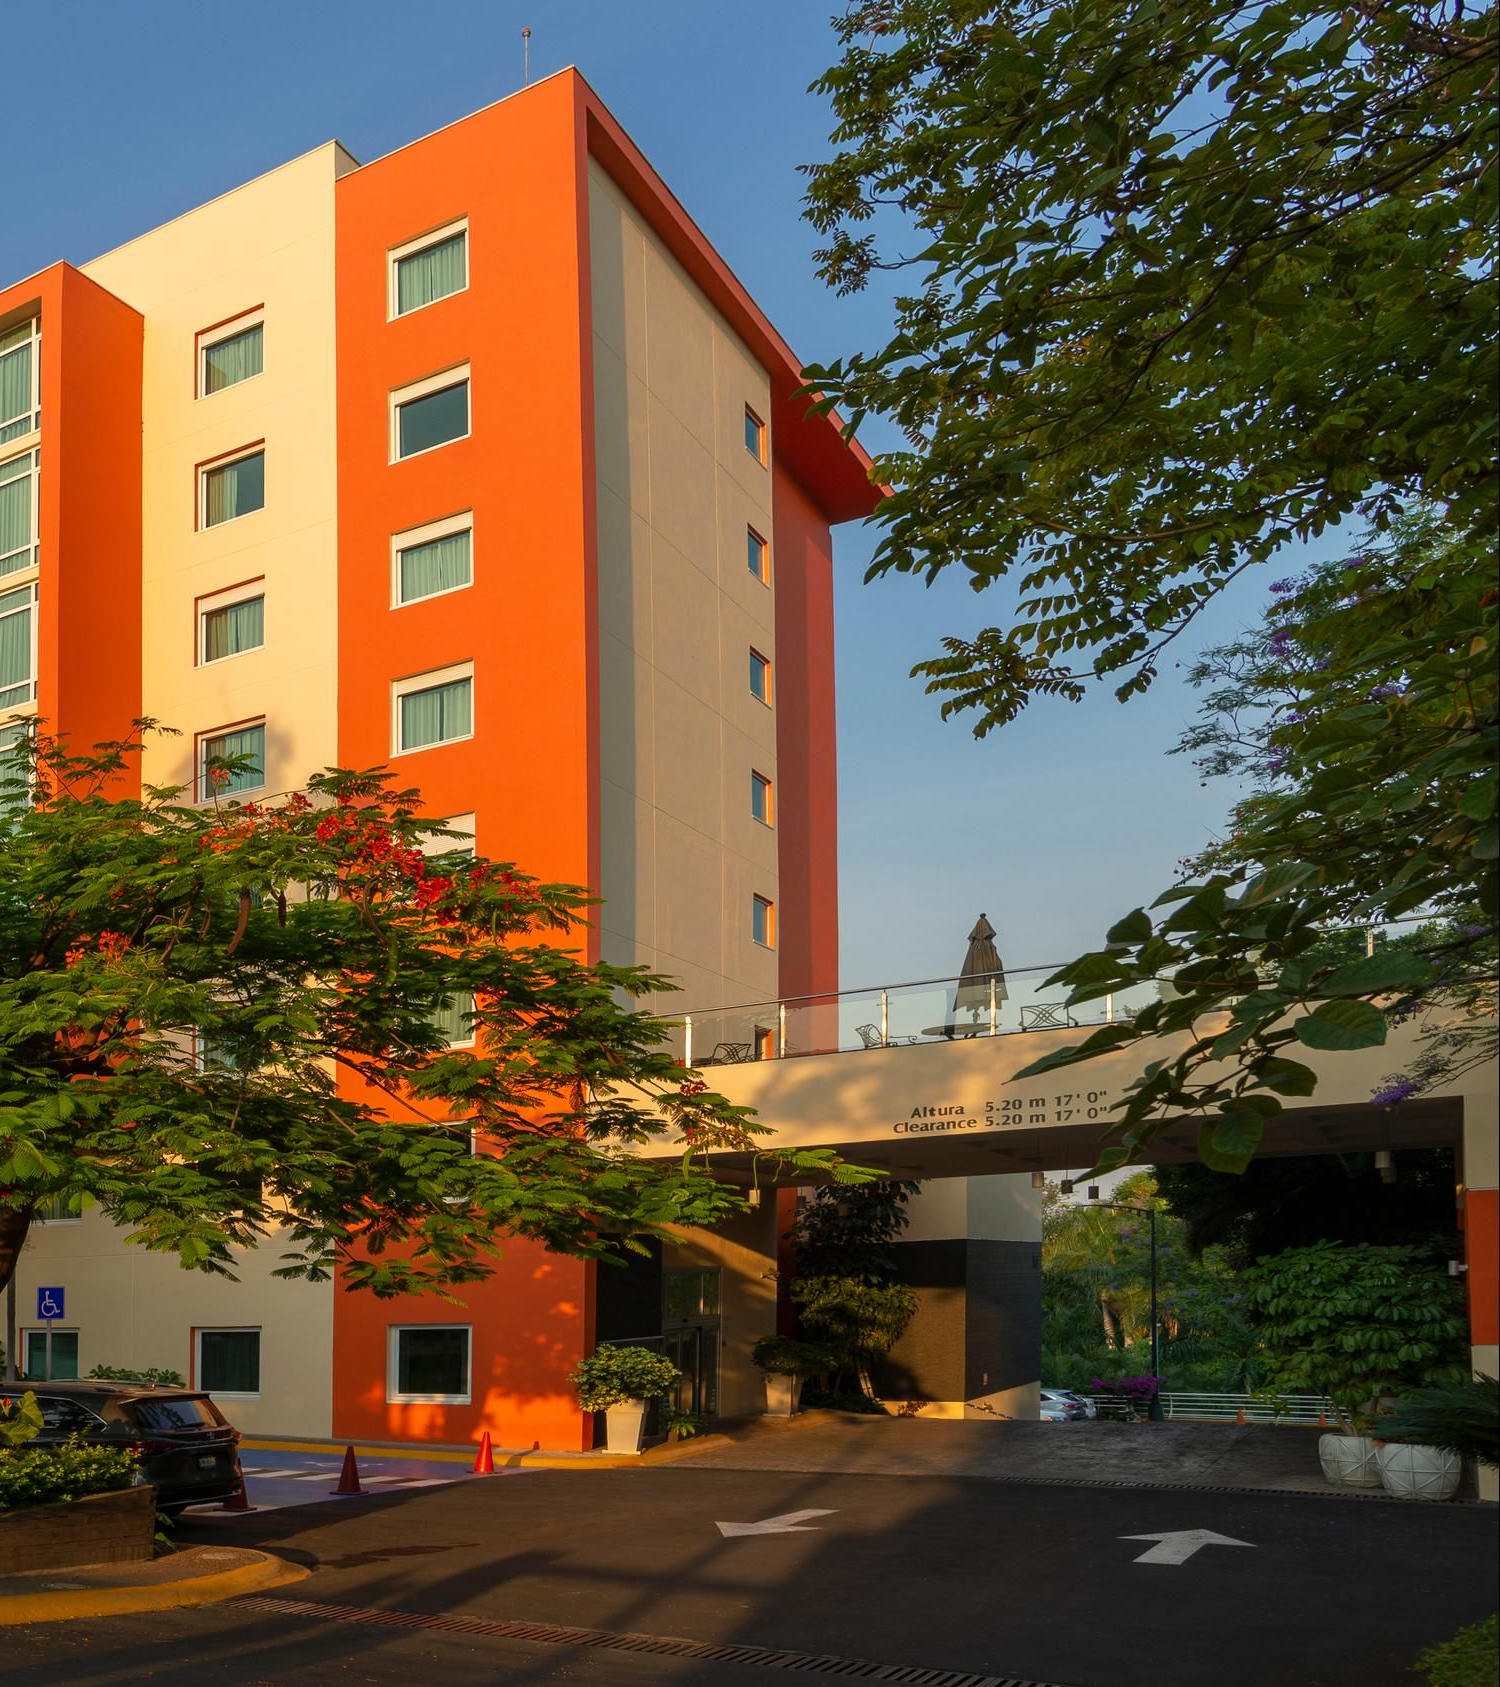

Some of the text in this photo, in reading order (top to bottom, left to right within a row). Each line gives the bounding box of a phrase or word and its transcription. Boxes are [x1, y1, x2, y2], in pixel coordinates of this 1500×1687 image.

[910, 1105, 965, 1119] Altura
[984, 1099, 1023, 1113] 5.20
[1028, 1097, 1046, 1108] m
[893, 1117, 977, 1134] Clearance
[984, 1113, 1023, 1127] 5.20
[1028, 1112, 1046, 1123] m
